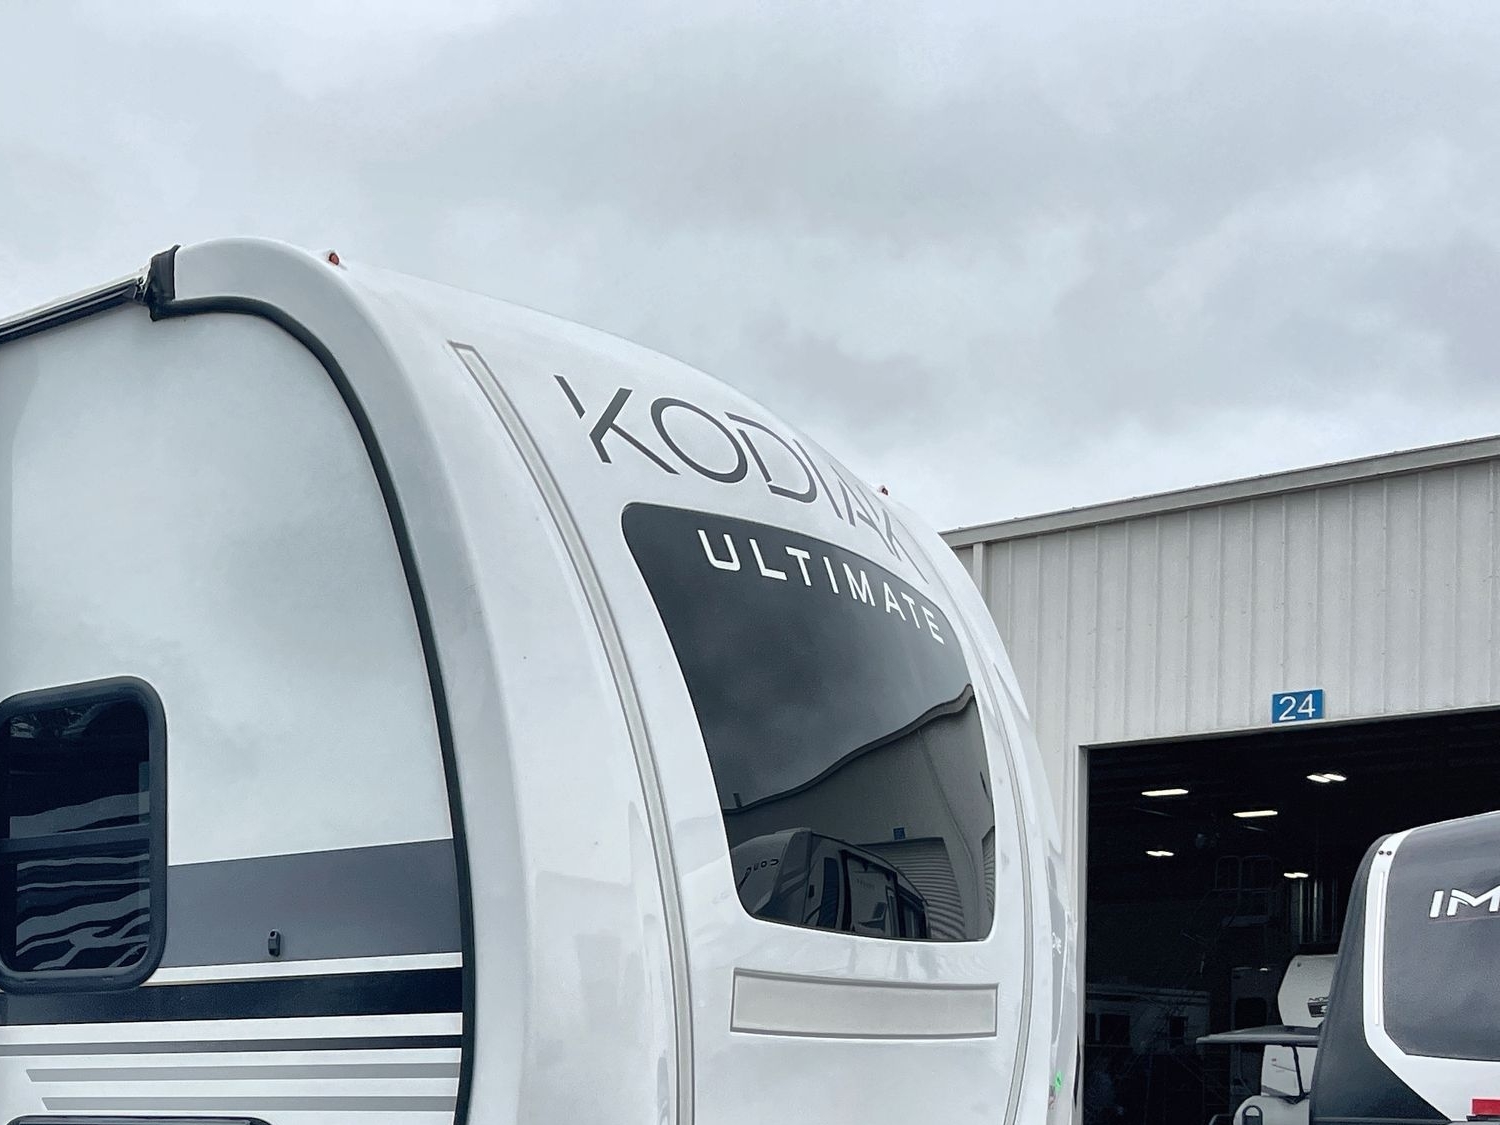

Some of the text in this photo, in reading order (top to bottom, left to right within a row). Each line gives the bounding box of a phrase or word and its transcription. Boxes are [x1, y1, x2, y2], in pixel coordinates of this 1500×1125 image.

[553, 373, 929, 585] KODIAK
[697, 529, 945, 645] ULTIMATE
[1278, 693, 1316, 721] 24
